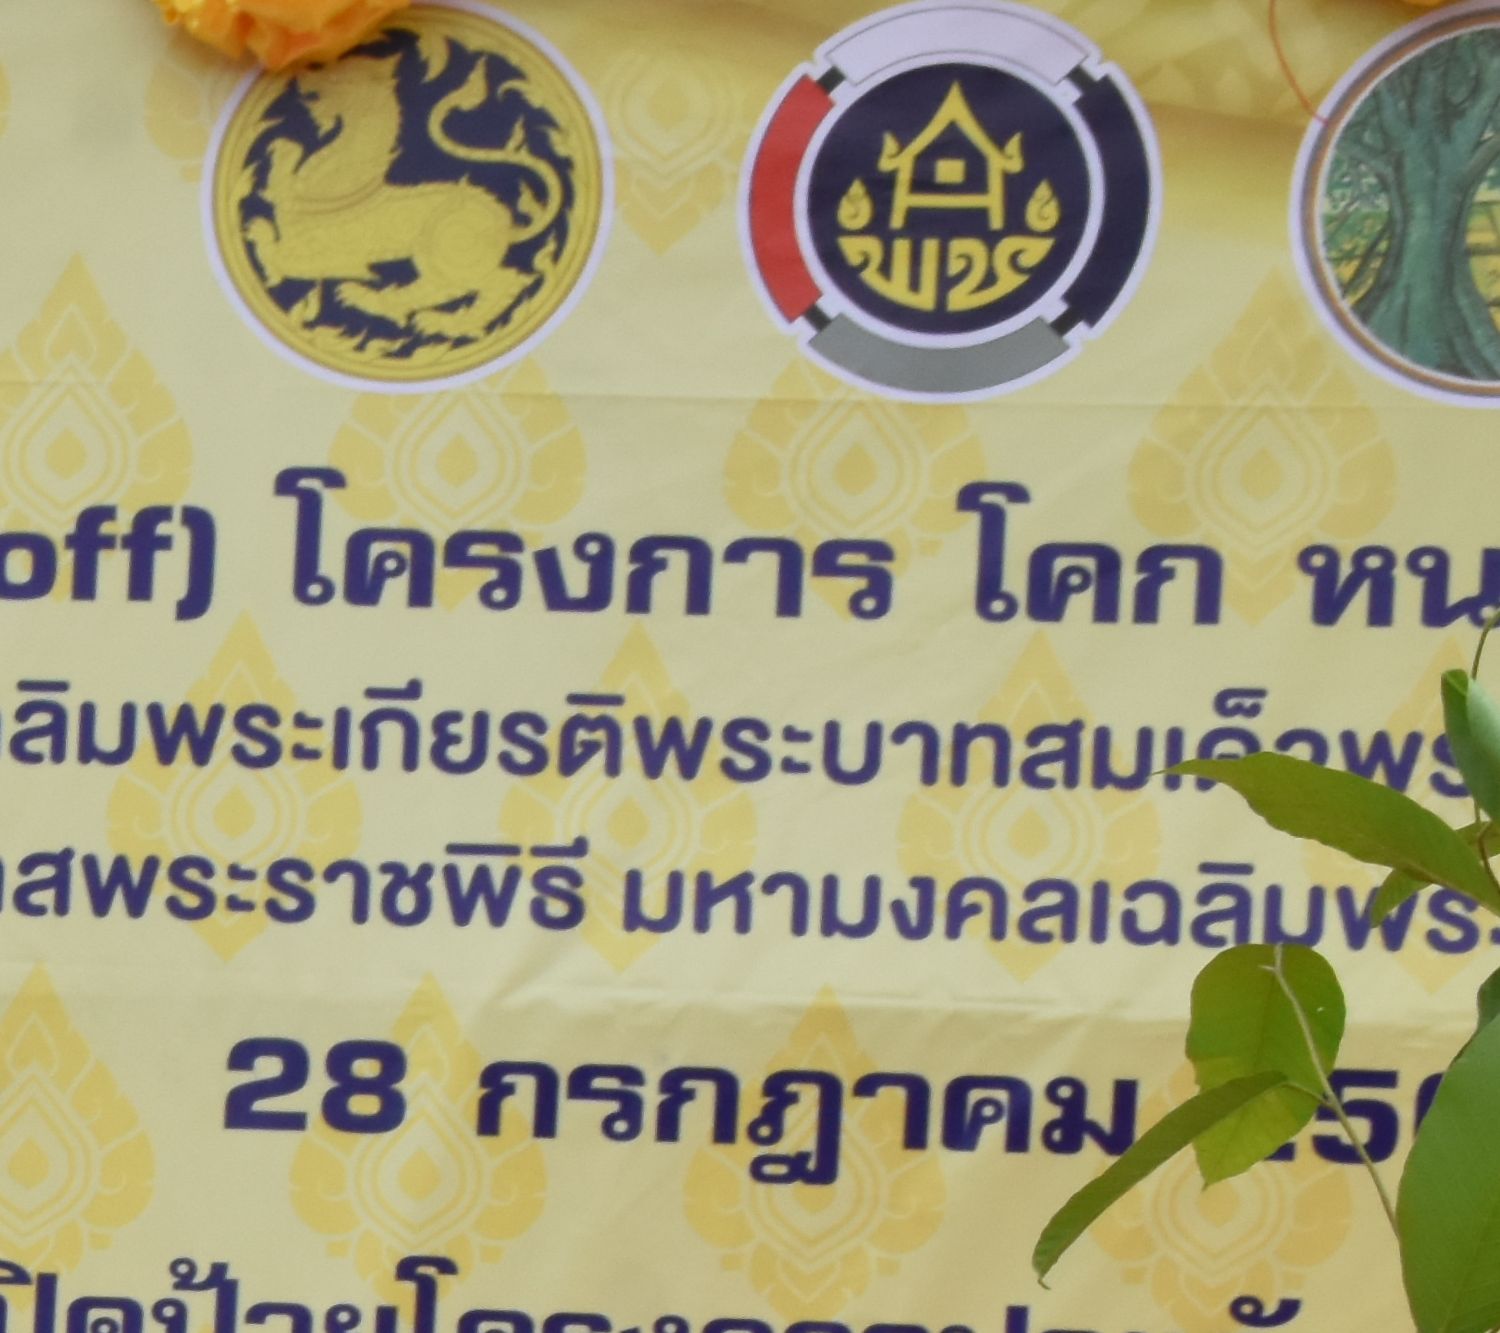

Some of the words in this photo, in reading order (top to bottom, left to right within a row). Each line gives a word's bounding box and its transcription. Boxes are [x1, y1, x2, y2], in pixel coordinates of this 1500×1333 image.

[273, 465, 896, 623] โครงการ
[956, 480, 1225, 627] โคก
[621, 860, 1500, 956] มหามงคลเฉลิมพร
[223, 1036, 409, 1136] 28
[476, 1059, 1140, 1187] กรกฎาคม
